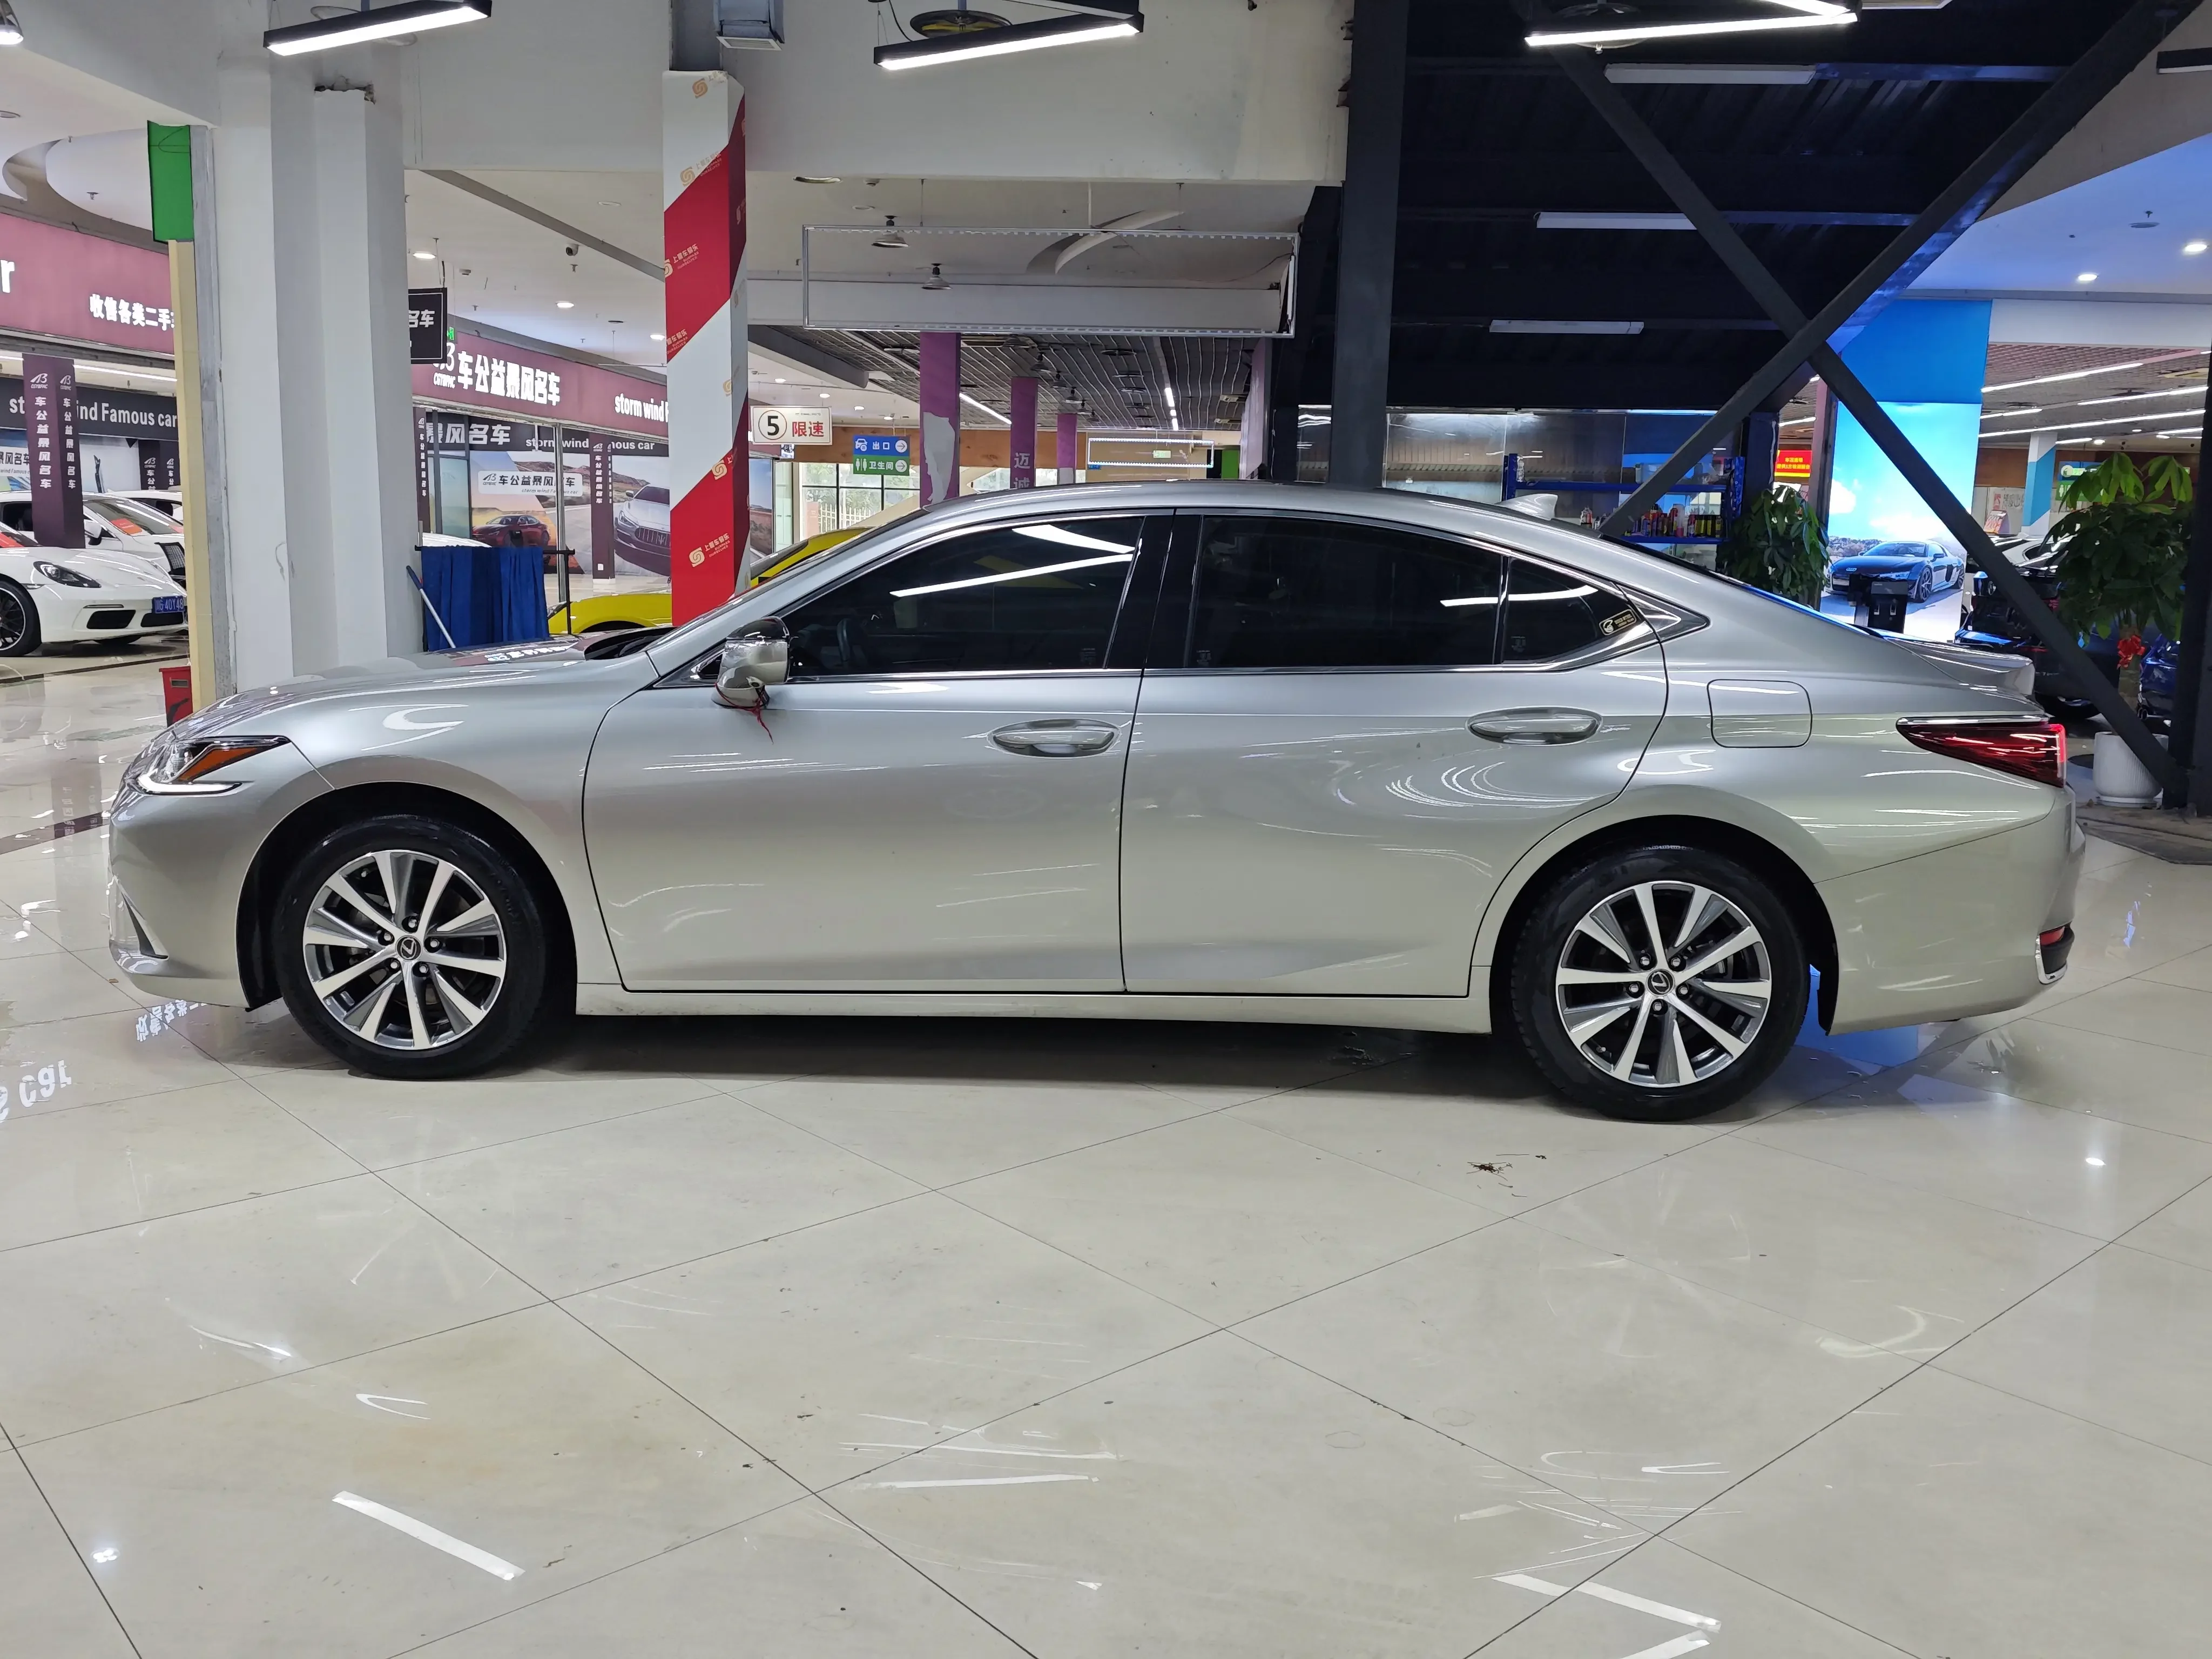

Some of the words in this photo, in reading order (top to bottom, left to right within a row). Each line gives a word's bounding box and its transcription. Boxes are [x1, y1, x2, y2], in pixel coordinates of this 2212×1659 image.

[90, 293, 174, 331] 收售各类二手
[457, 350, 561, 406] 车公益暴风名车
[102, 402, 155, 426] Famous
[158, 413, 177, 428] car
[615, 393, 643, 417] storm
[643, 397, 664, 422] wind
[767, 415, 780, 436] 5
[792, 421, 824, 437] 限速
[562, 438, 589, 448] wind
[637, 441, 655, 450] car
[872, 441, 890, 450] 出口
[868, 461, 894, 470] 卫生间
[498, 475, 576, 487] 车公益暴风车
